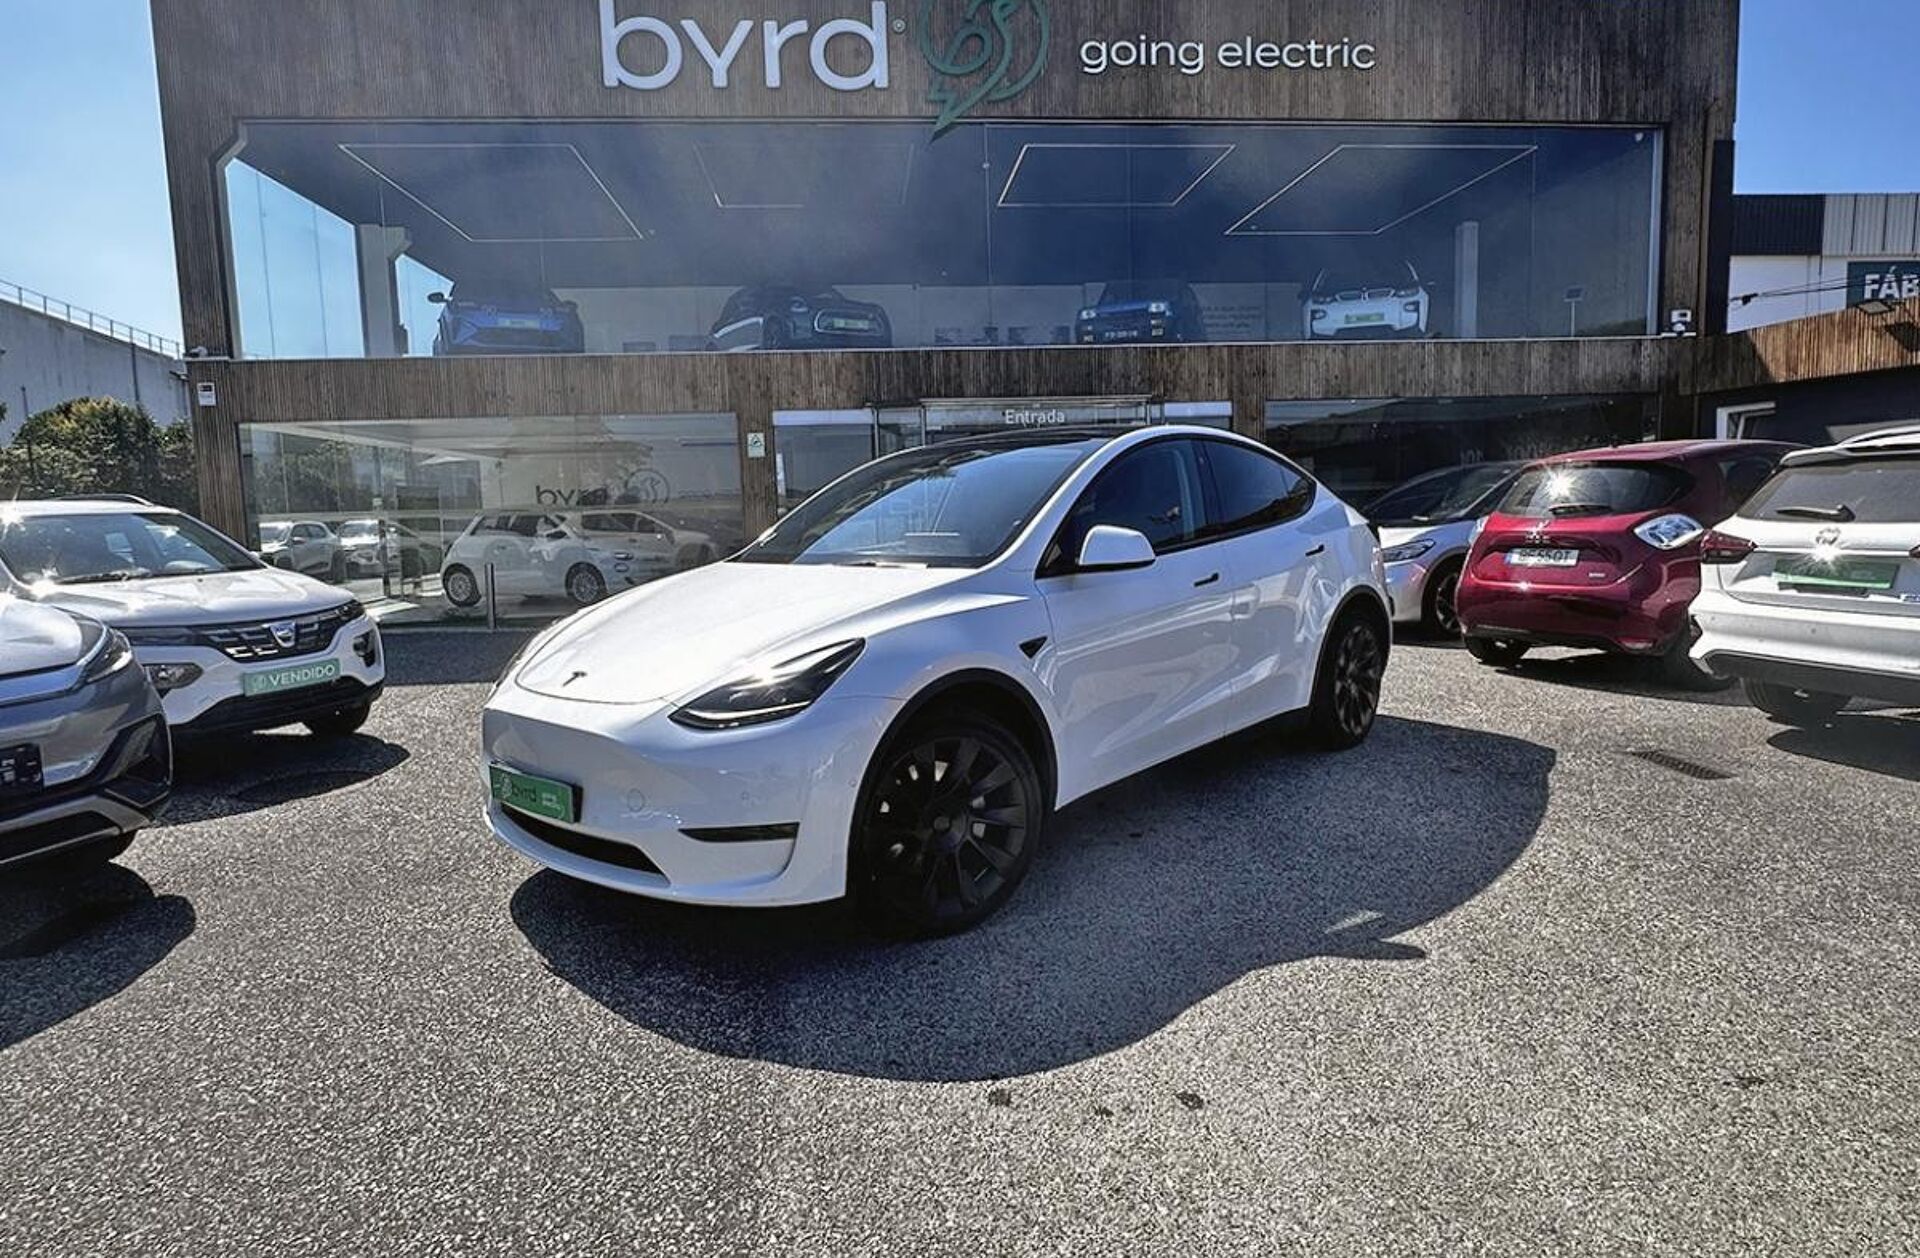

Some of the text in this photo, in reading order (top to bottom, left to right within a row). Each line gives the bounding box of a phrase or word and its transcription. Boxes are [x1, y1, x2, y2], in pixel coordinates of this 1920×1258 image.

[600, 0, 889, 90] byrd
[1080, 34, 1376, 74] going electric
[1005, 409, 1065, 425] Entrada
[268, 664, 335, 686] VENDIDO
